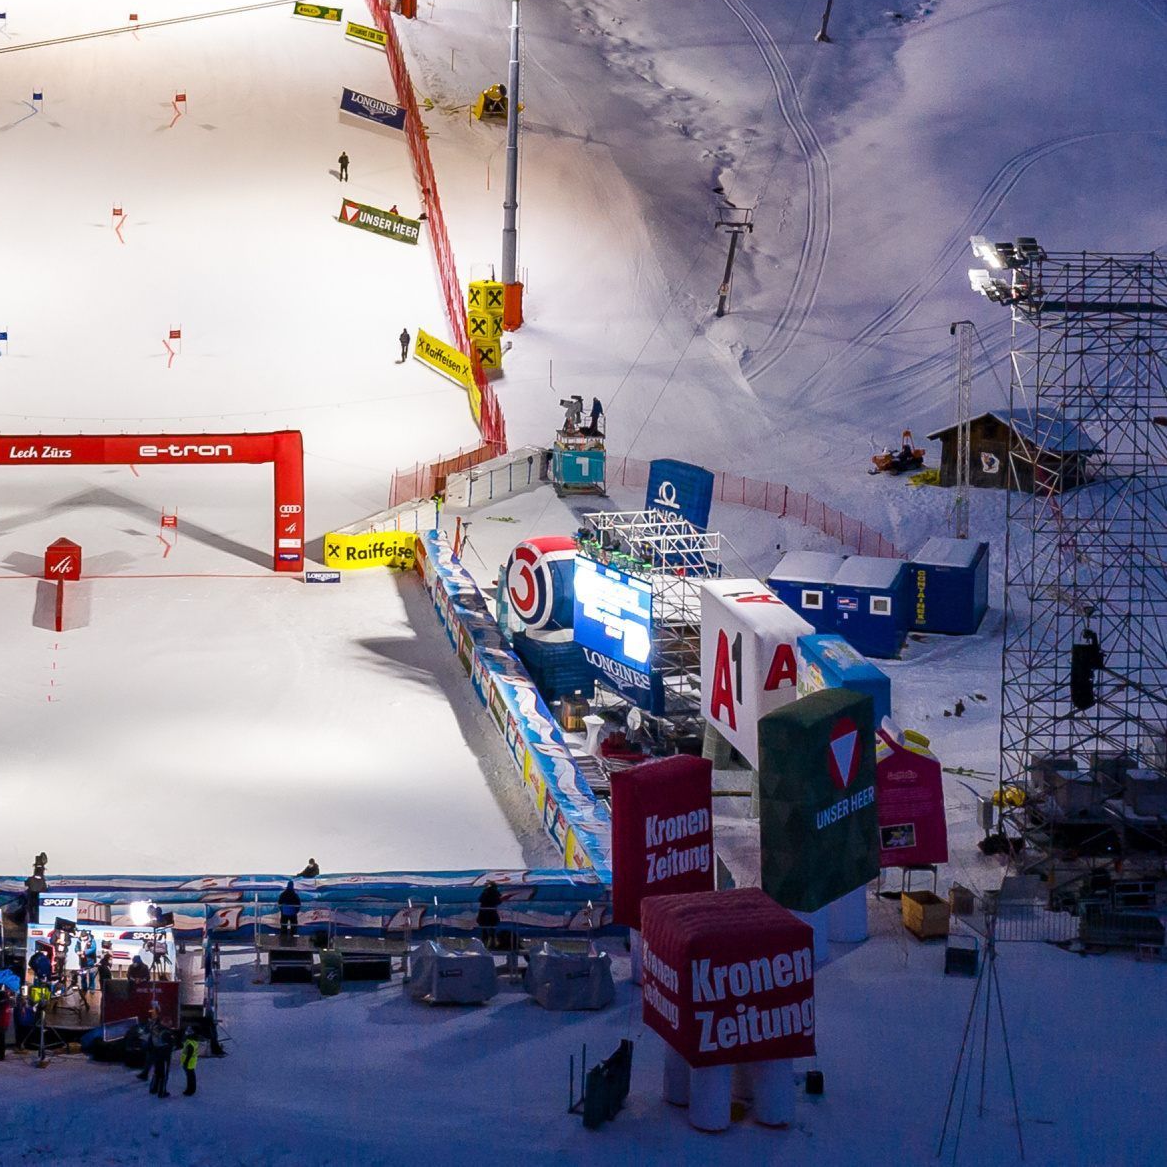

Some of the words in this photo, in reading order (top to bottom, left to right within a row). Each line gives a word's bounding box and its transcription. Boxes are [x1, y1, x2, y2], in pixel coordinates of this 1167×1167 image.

[351, 92, 397, 116] LONGINES
[359, 211, 392, 230] UNSER
[393, 221, 418, 238] HEER
[426, 342, 461, 373] Raiffeisen
[9, 446, 38, 458] Lech
[41, 446, 72, 459] Zürs
[139, 444, 232, 456] e-tron
[576, 457, 589, 476] 1
[346, 542, 414, 561] Raiffeise
[583, 647, 650, 690] LONGINES
[711, 627, 742, 732] A1
[646, 808, 709, 848] Kronen
[816, 799, 848, 830] UNSER
[851, 786, 874, 812] HEER
[646, 843, 710, 884] Zeitung
[691, 947, 811, 1002] Kronen
[644, 973, 679, 1030] eitung
[695, 996, 814, 1052] Zeitung
